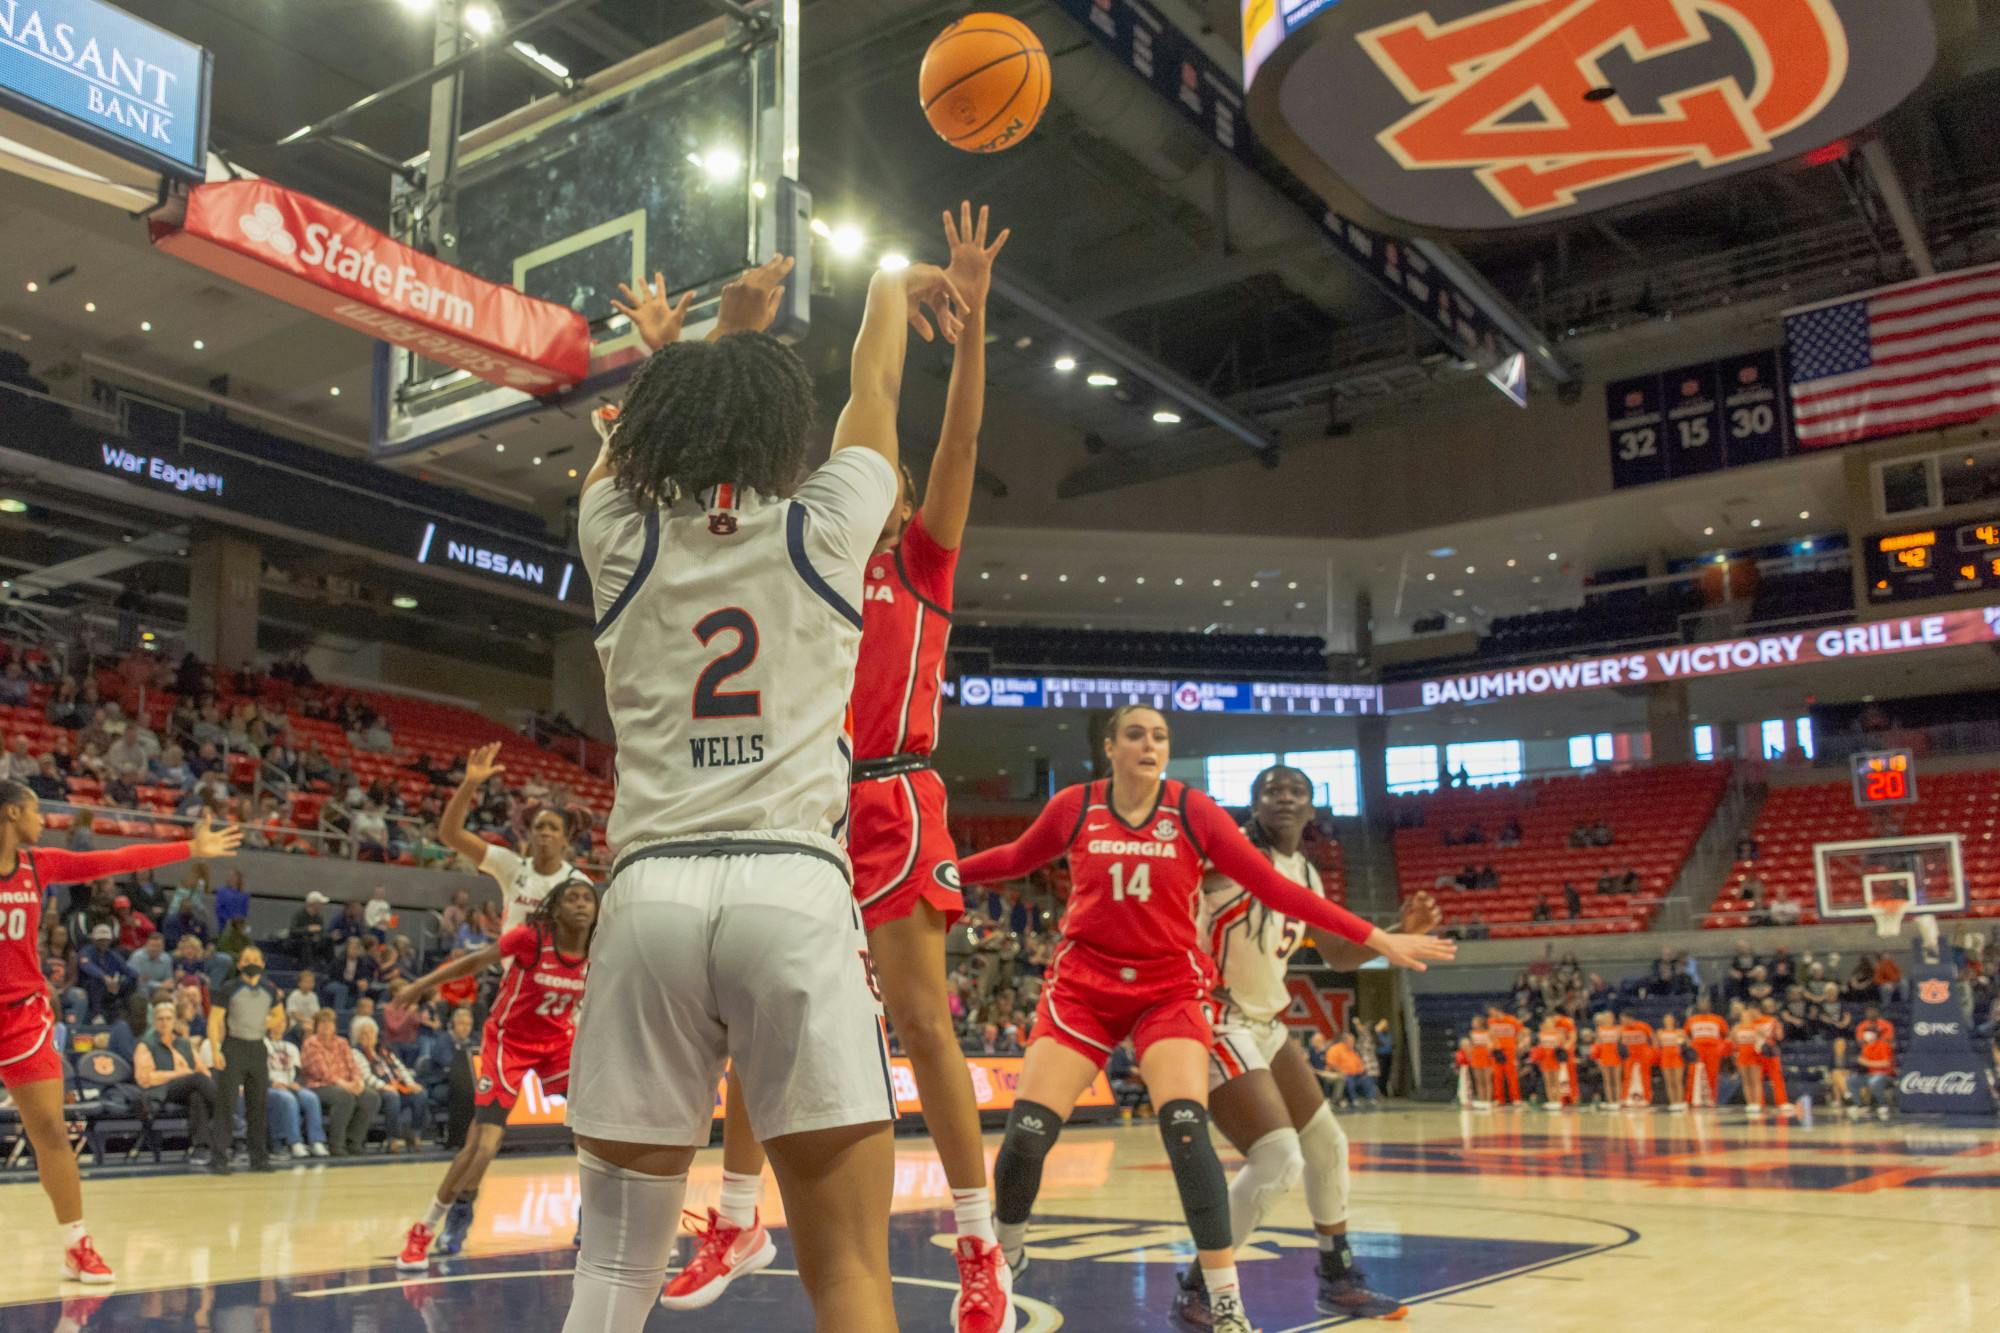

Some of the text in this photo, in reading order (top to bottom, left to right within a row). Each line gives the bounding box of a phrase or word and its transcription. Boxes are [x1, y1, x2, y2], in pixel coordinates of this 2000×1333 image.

[87, 85, 172, 144] BANK
[1677, 417, 1710, 449] 15
[1730, 404, 1774, 438] 30
[102, 443, 147, 474] War
[1618, 428, 1658, 460] 32
[447, 540, 544, 585] NISSAN
[692, 606, 762, 720] 2
[1421, 655, 1648, 706] BAUMHOWER'S
[1656, 634, 1804, 676] VICTORY
[1816, 616, 1947, 657] GRILLE
[690, 734, 764, 768] WELLS
[1866, 771, 1905, 801] 20
[1087, 839, 1178, 859] GEORGIA
[1108, 861, 1152, 903] 14
[534, 991, 574, 1017] 23
